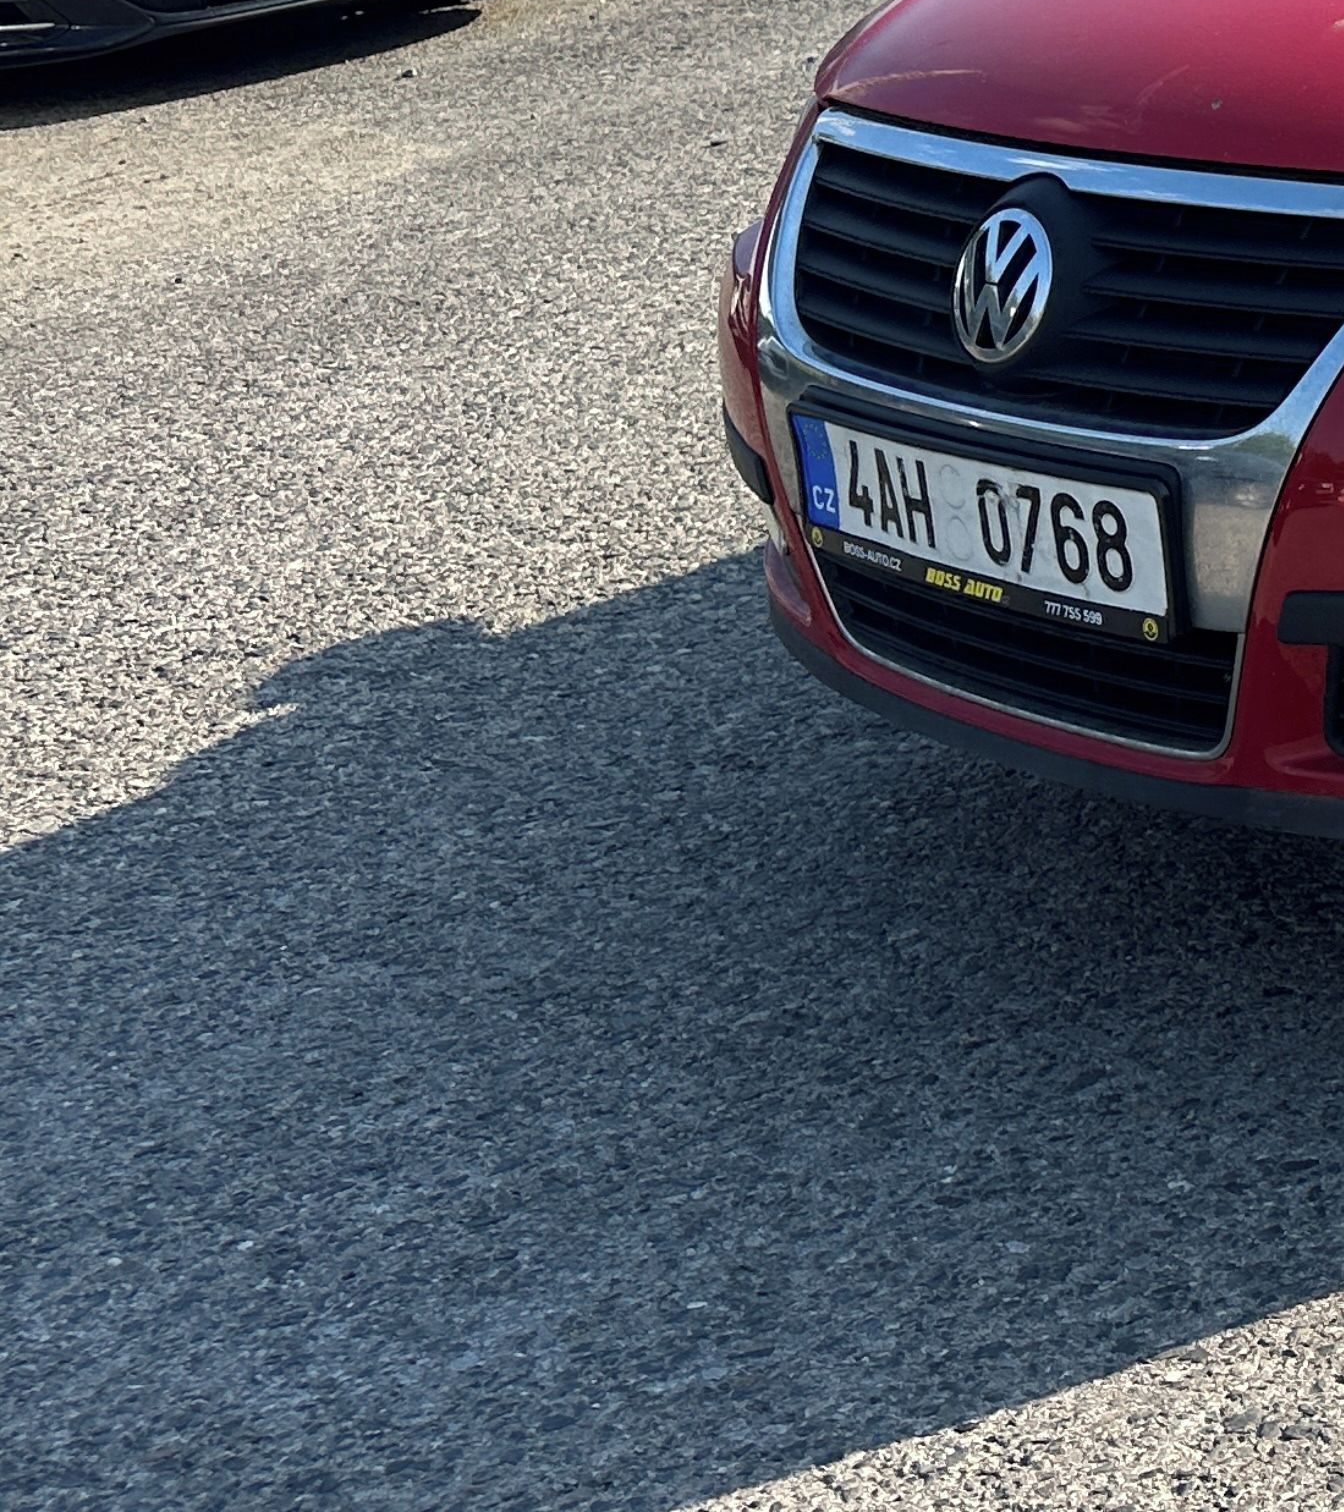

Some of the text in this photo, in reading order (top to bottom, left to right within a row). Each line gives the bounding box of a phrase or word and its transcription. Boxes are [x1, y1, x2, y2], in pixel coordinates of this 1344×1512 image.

[812, 485, 836, 514] CZ
[847, 440, 1133, 592] 4AH 0768
[925, 567, 1003, 603] BOSS AUTO
[1044, 600, 1061, 616] 777
[1082, 608, 1103, 626] 599
